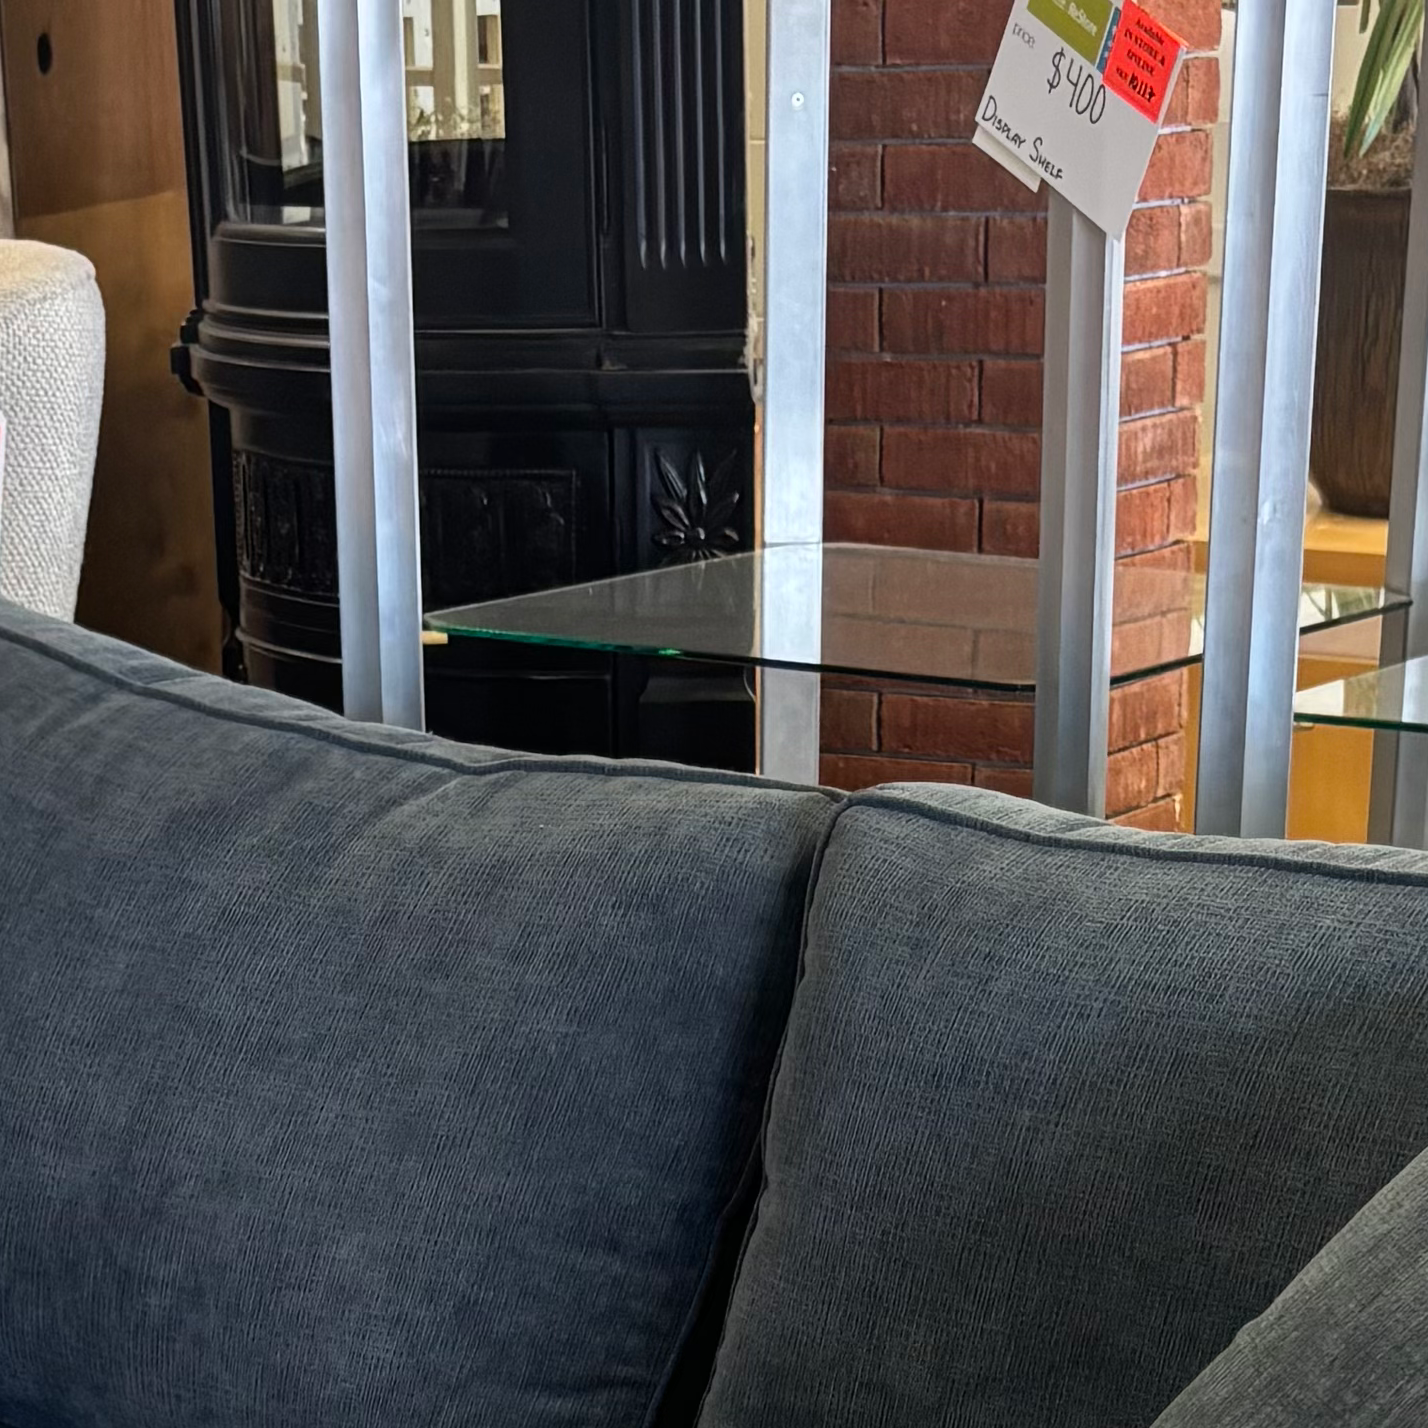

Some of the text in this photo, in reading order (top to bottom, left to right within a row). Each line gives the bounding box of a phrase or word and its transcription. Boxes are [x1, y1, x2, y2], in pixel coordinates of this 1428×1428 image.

[1046, 46, 1106, 125] $400
[981, 94, 1064, 181] DISPLAY SHELF
